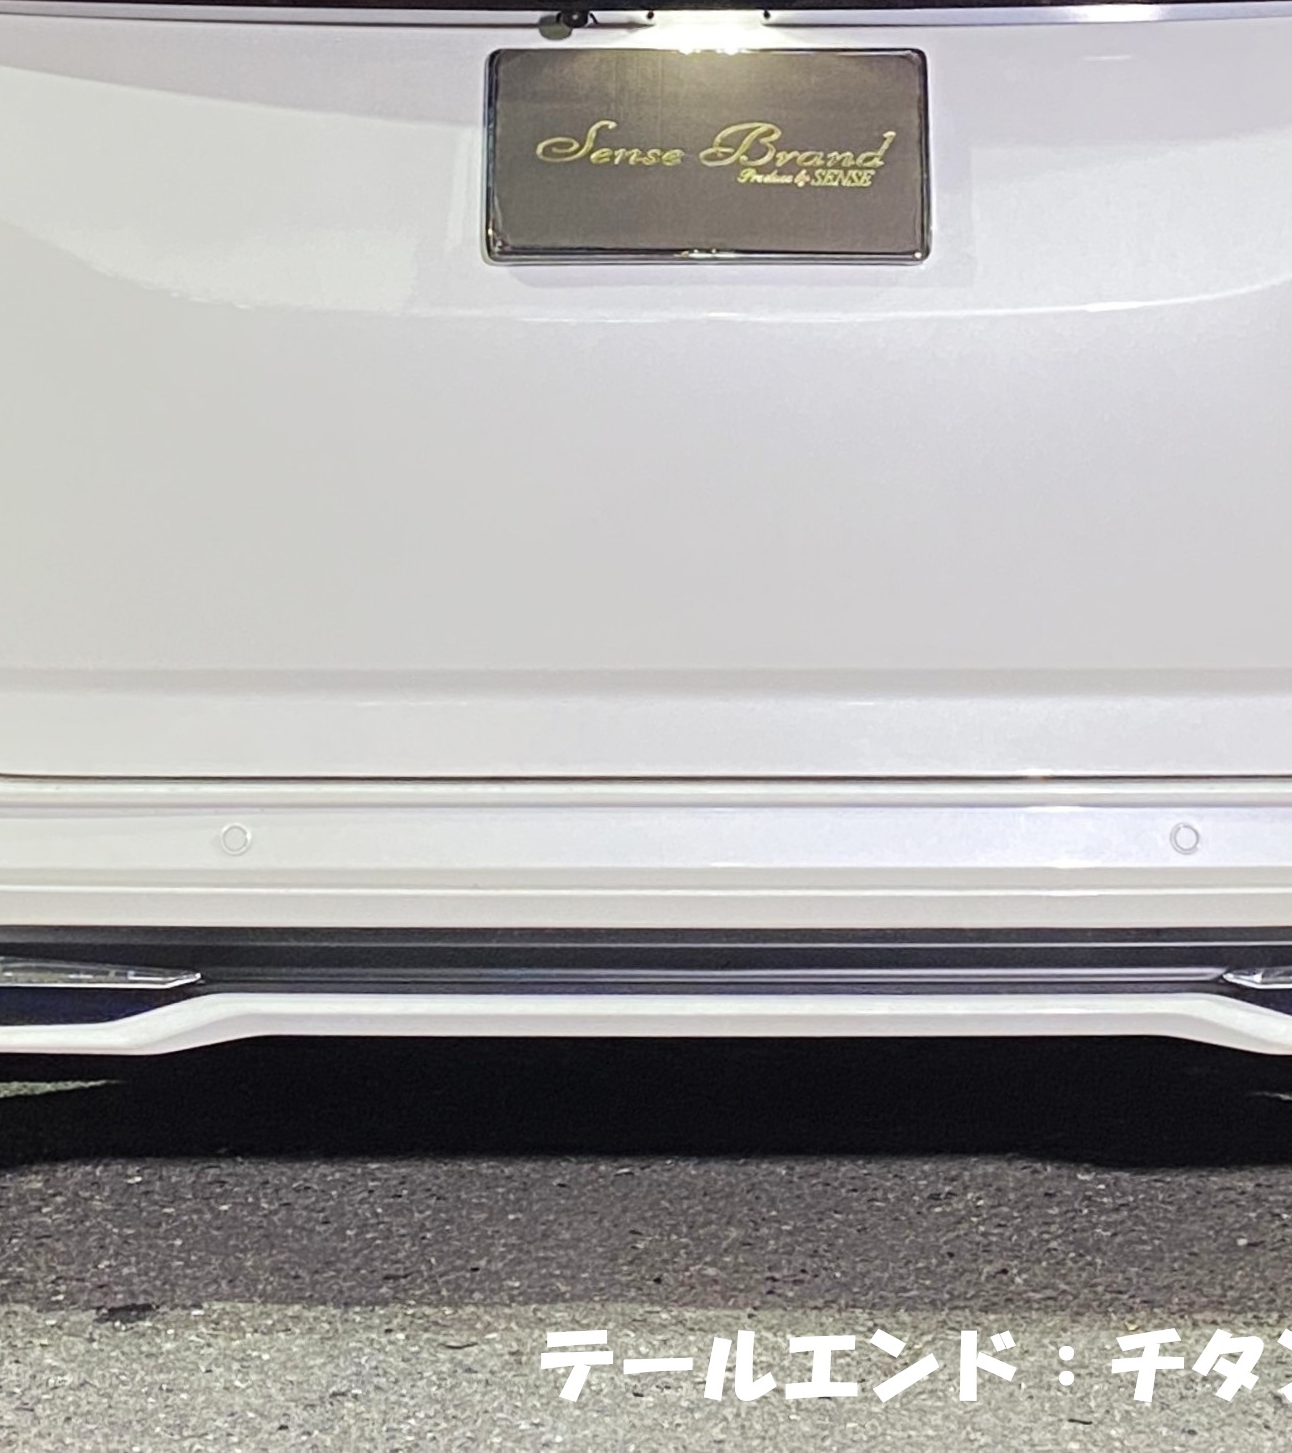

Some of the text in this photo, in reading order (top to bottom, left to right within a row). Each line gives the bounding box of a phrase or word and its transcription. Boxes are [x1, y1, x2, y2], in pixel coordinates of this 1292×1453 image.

[536, 120, 896, 167] Sense Brand
[811, 168, 876, 187] SENSE
